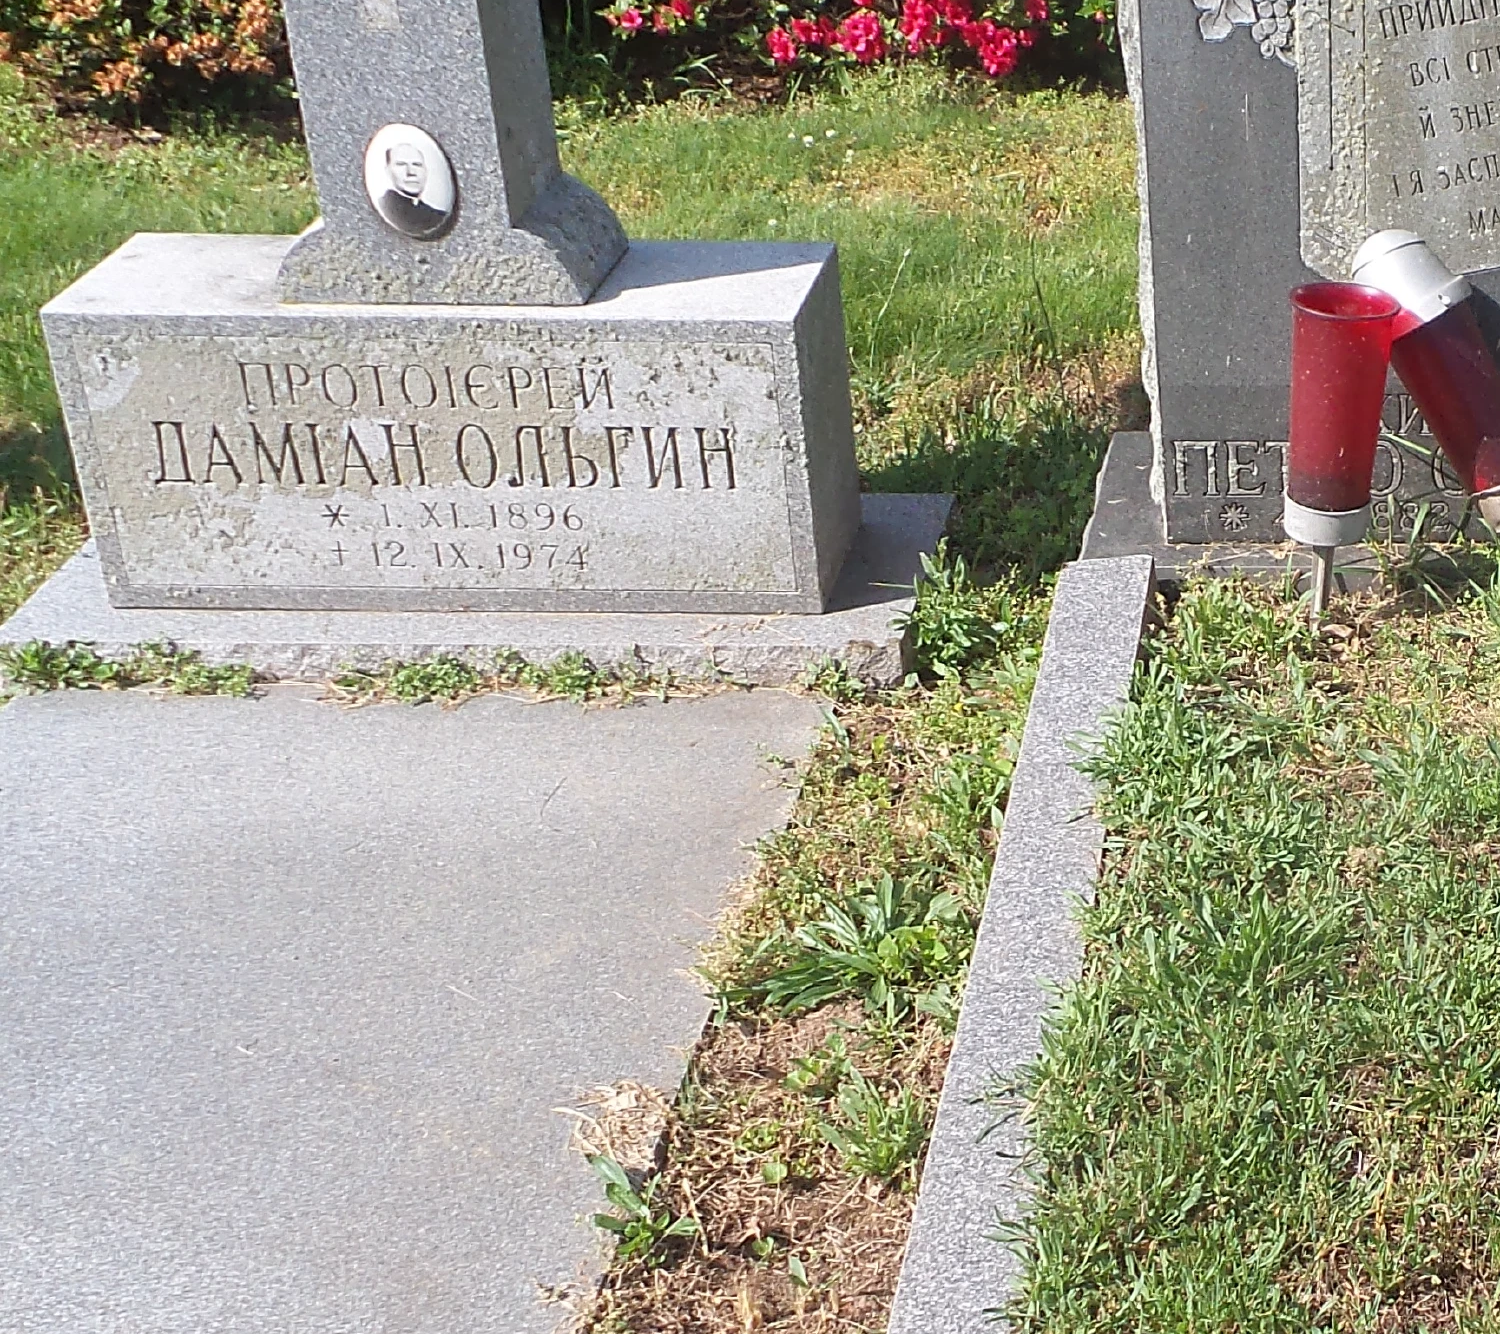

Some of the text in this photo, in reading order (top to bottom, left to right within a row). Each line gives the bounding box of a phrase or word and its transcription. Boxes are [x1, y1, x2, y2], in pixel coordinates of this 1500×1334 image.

[1409, 57, 1451, 87] ВСІ
[1418, 106, 1437, 139] Й
[1409, 169, 1425, 196] Я
[237, 357, 617, 413] ПРОТОІЄРЕЙ
[151, 419, 739, 491] ДАМІАН ОЛЬГИН
[488, 501, 585, 531] 1896
[496, 542, 590, 571] 1974
